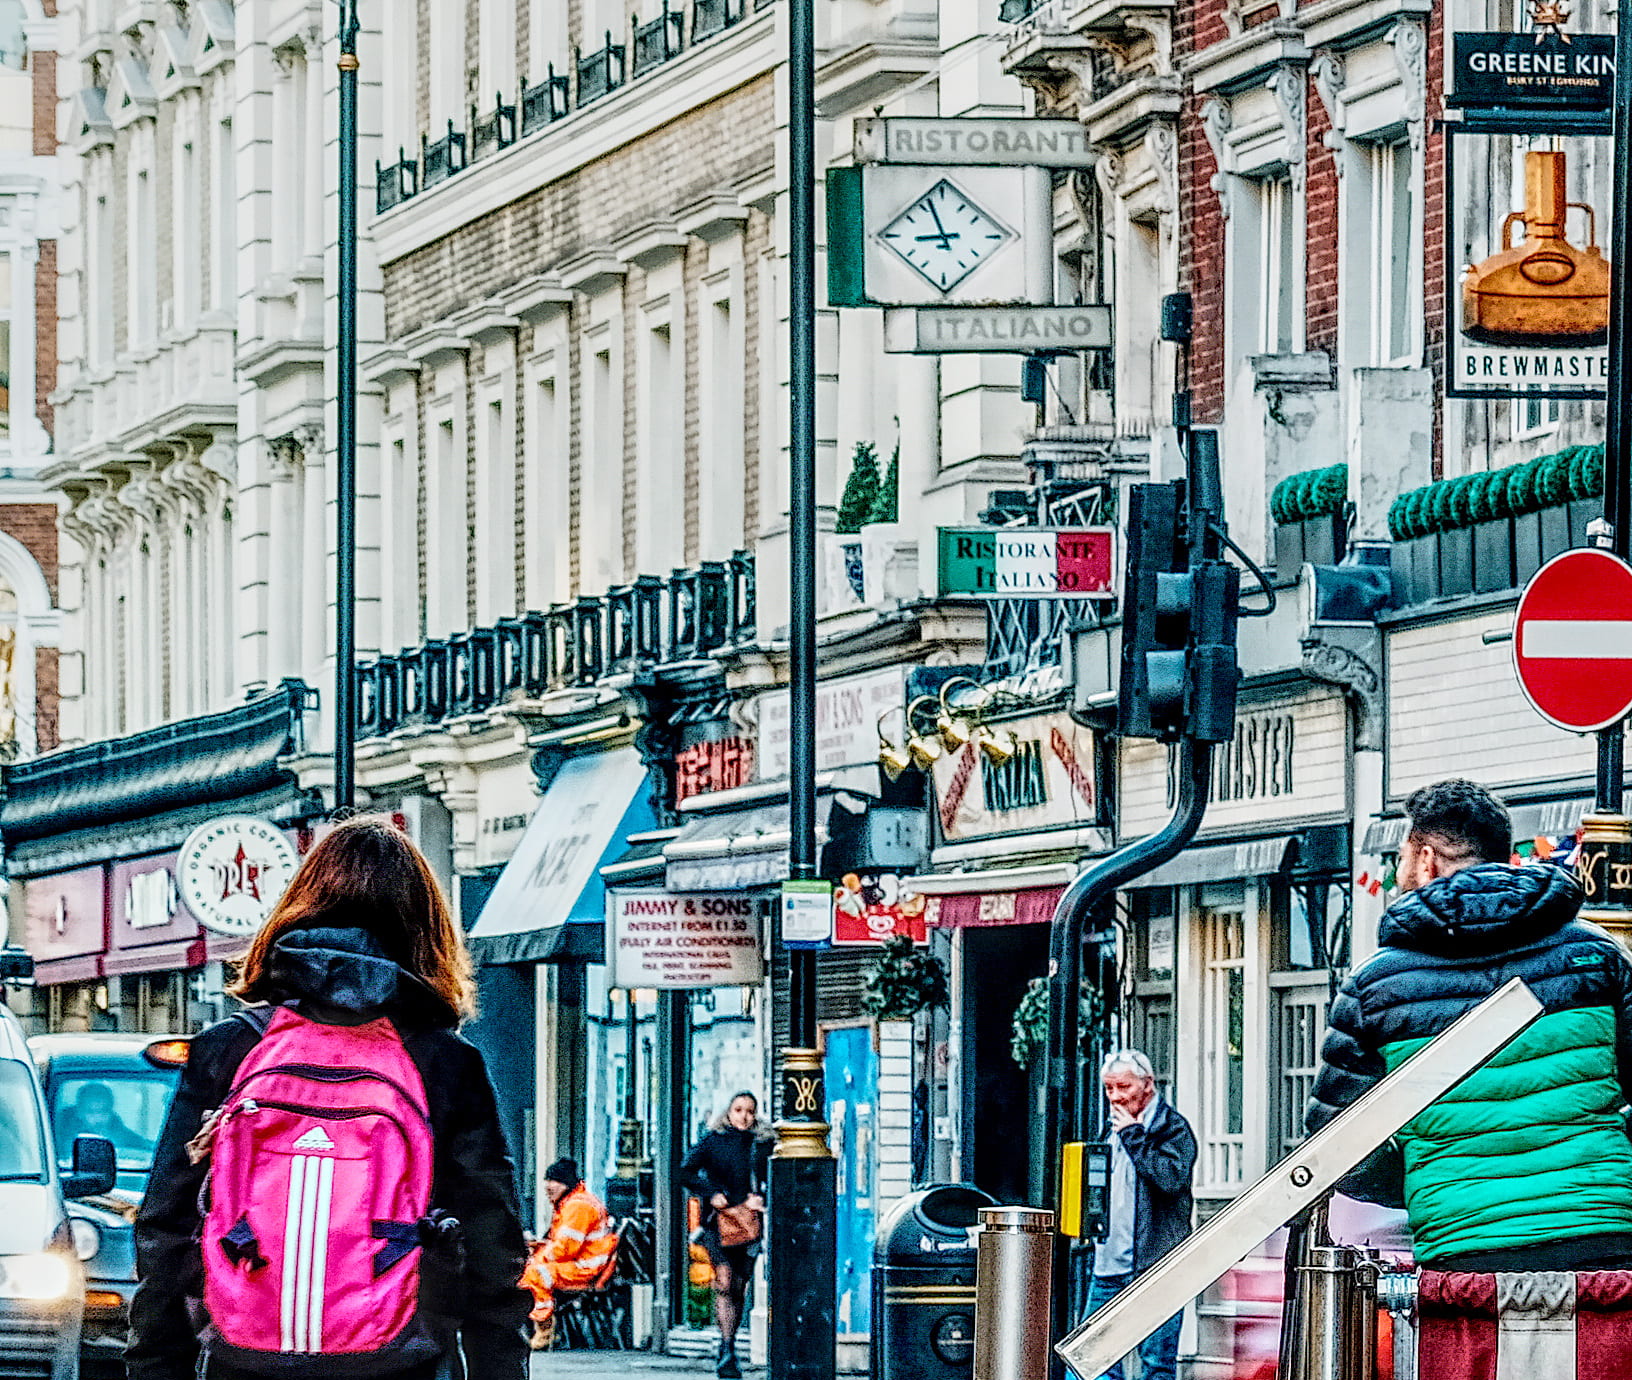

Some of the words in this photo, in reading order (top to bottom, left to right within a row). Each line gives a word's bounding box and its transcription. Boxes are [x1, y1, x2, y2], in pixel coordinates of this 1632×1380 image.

[1469, 52, 1566, 74] GREENE
[1575, 54, 1616, 75] KIN
[895, 129, 1089, 153] RISTORANT
[935, 315, 1092, 340] ITALIANO
[1466, 355, 1608, 377] BREWMASTE
[956, 537, 1096, 559] RISTORANTE
[976, 566, 1079, 588] ITALIANO
[212, 858, 269, 899] PRET
[622, 899, 679, 917] JIMMY
[684, 899, 697, 916] &
[701, 898, 753, 917] SONS
